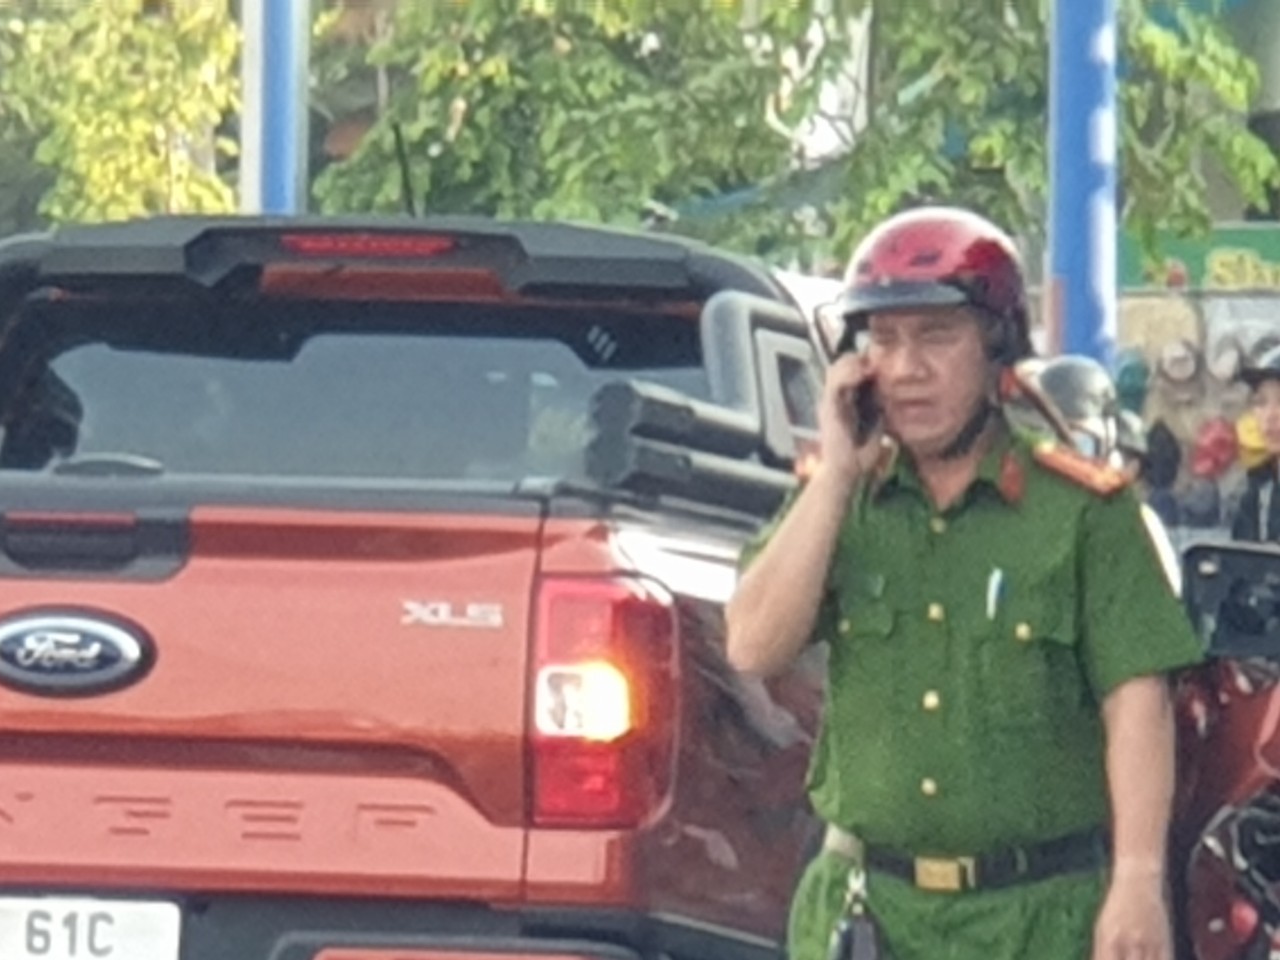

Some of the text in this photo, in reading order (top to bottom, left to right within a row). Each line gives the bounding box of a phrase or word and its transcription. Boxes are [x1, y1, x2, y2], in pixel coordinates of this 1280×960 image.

[401, 600, 503, 628] XLS
[17, 632, 101, 667] Ford
[25, 910, 115, 957] 61C
